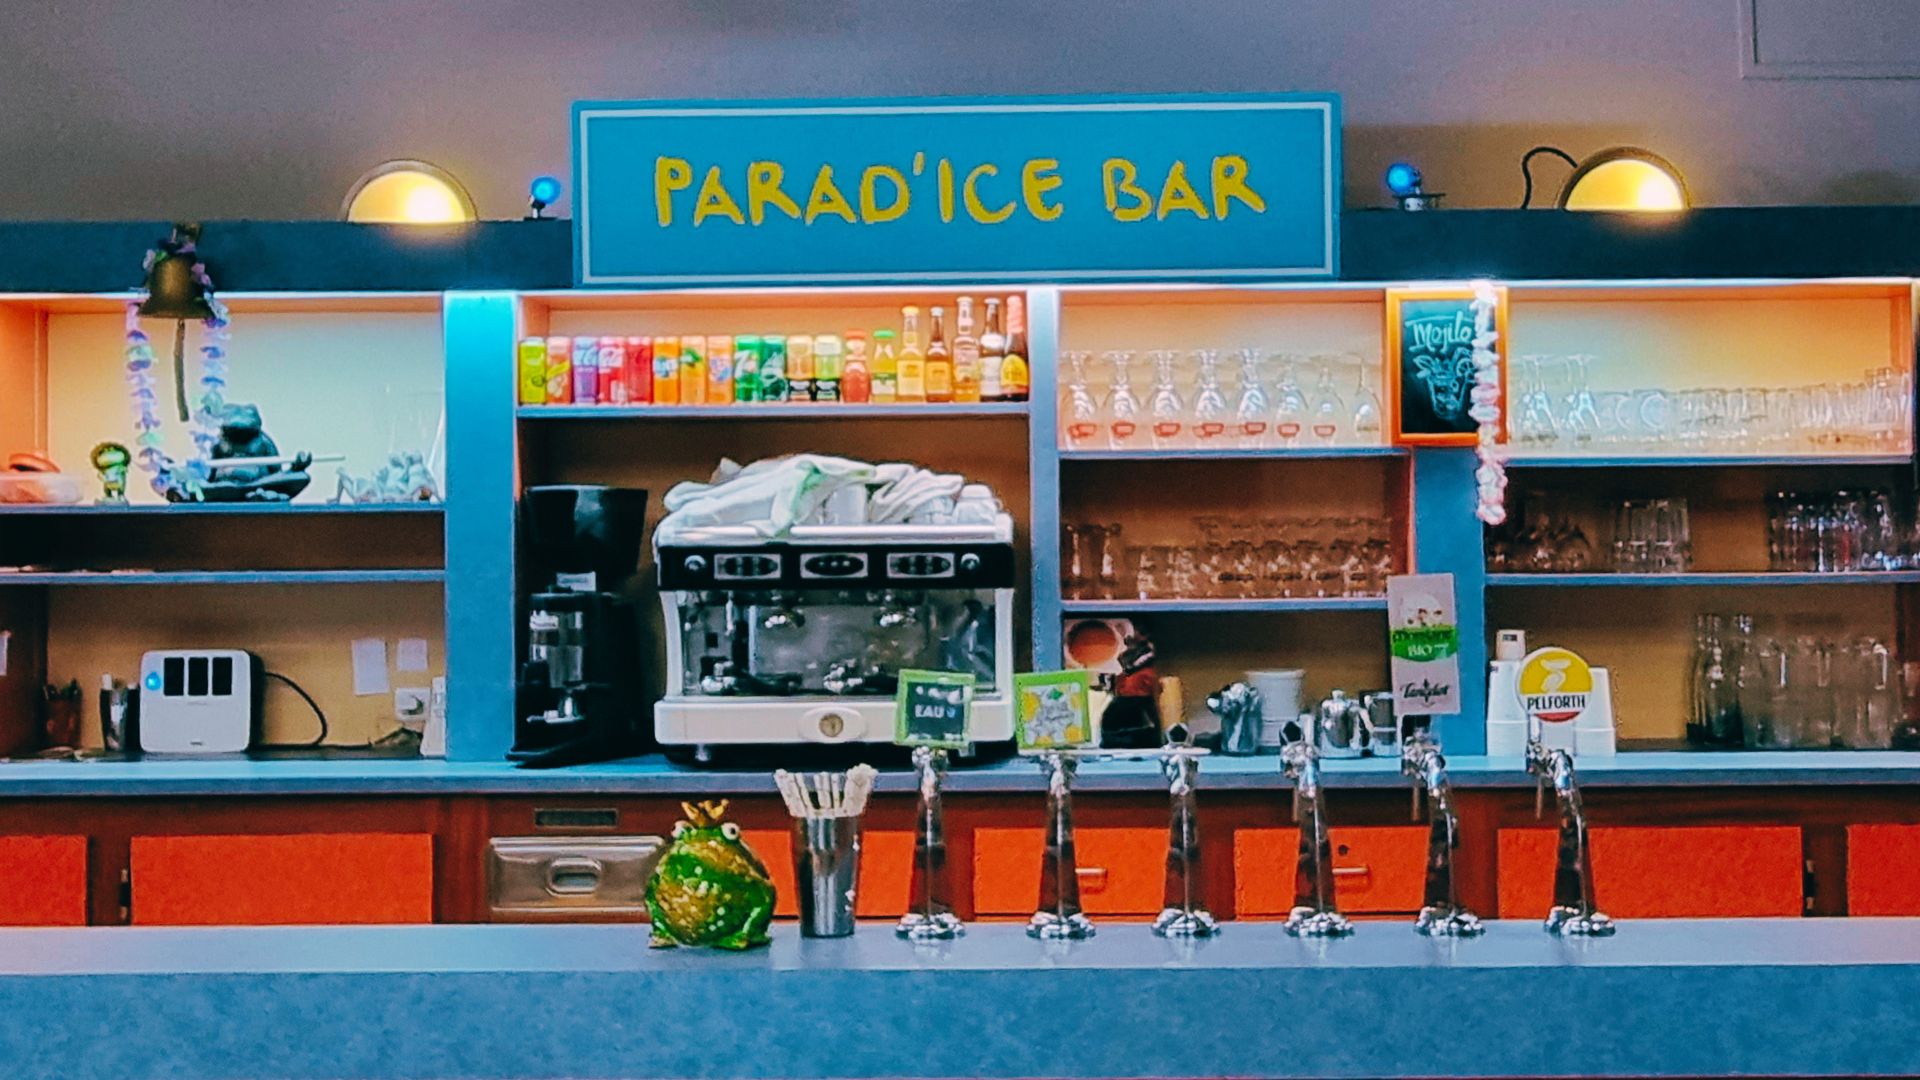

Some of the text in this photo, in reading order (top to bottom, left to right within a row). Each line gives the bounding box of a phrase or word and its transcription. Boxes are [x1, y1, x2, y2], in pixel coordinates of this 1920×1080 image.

[655, 150, 1267, 227] PARAD'ICE BAR
[914, 704, 945, 718] EAU
[1527, 694, 1586, 711] PELFORTH
